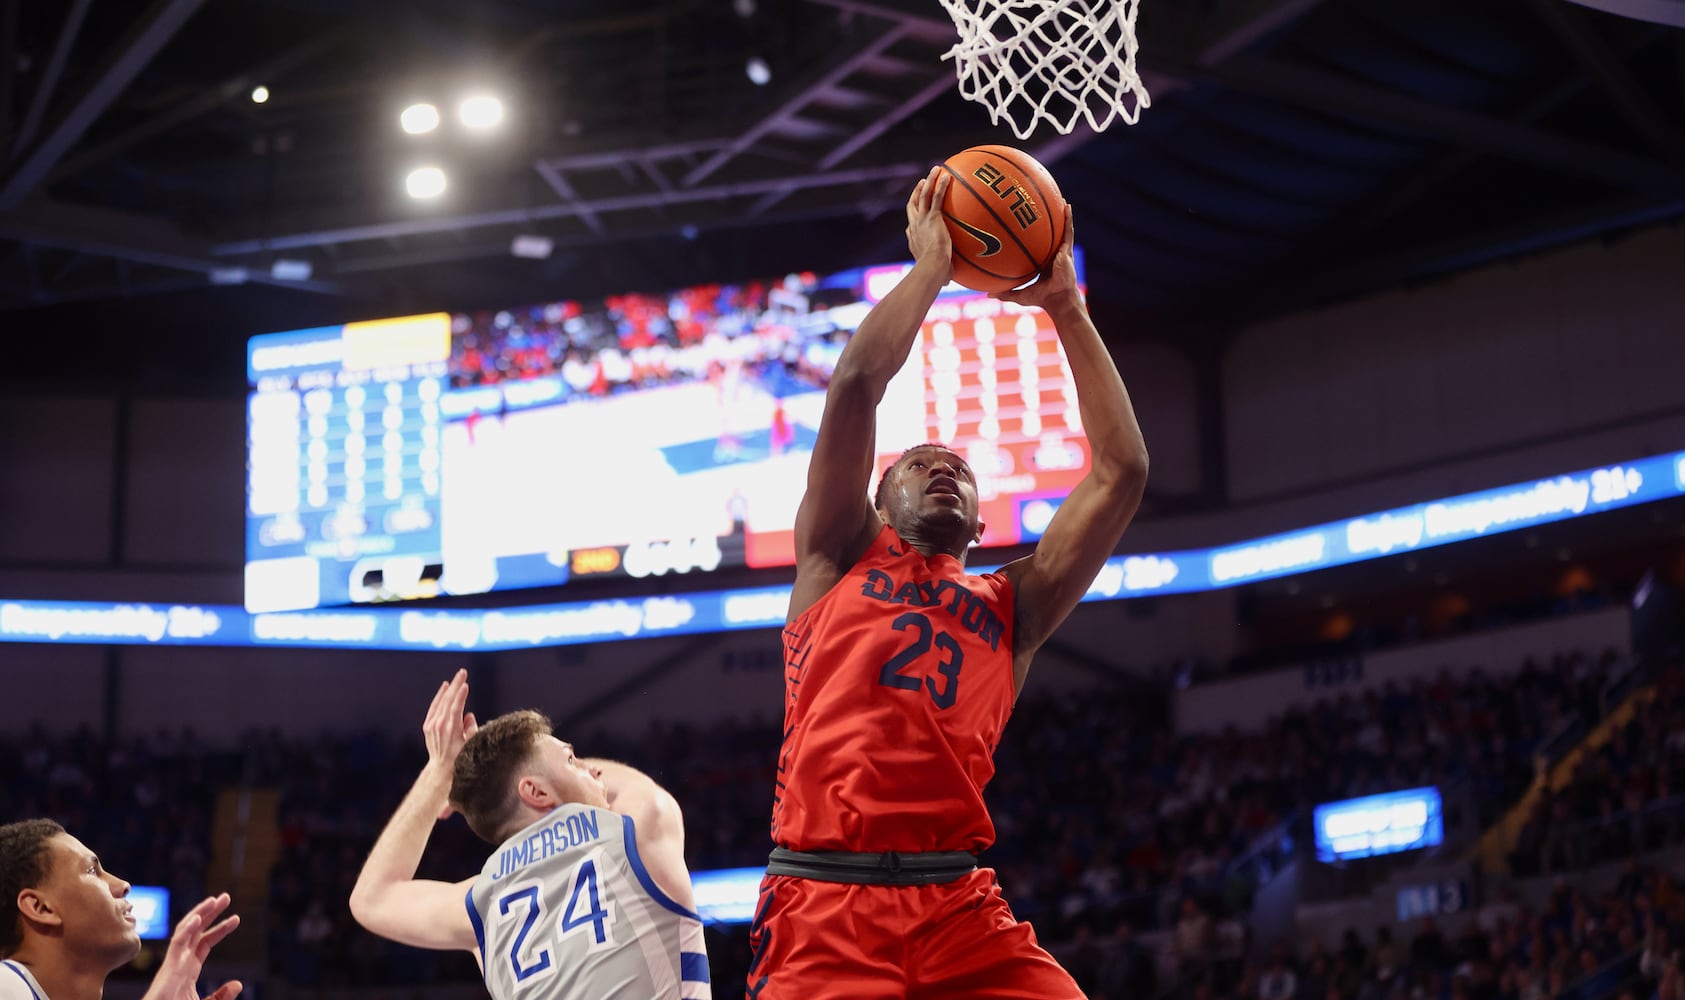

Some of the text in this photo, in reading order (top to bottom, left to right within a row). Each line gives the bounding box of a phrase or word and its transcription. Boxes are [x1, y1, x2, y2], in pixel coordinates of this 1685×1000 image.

[972, 162, 1038, 230] ELITE
[861, 568, 1006, 652] DAYTON
[878, 612, 964, 710] 23
[492, 810, 600, 881] JIMERSON
[498, 854, 614, 988] 24
